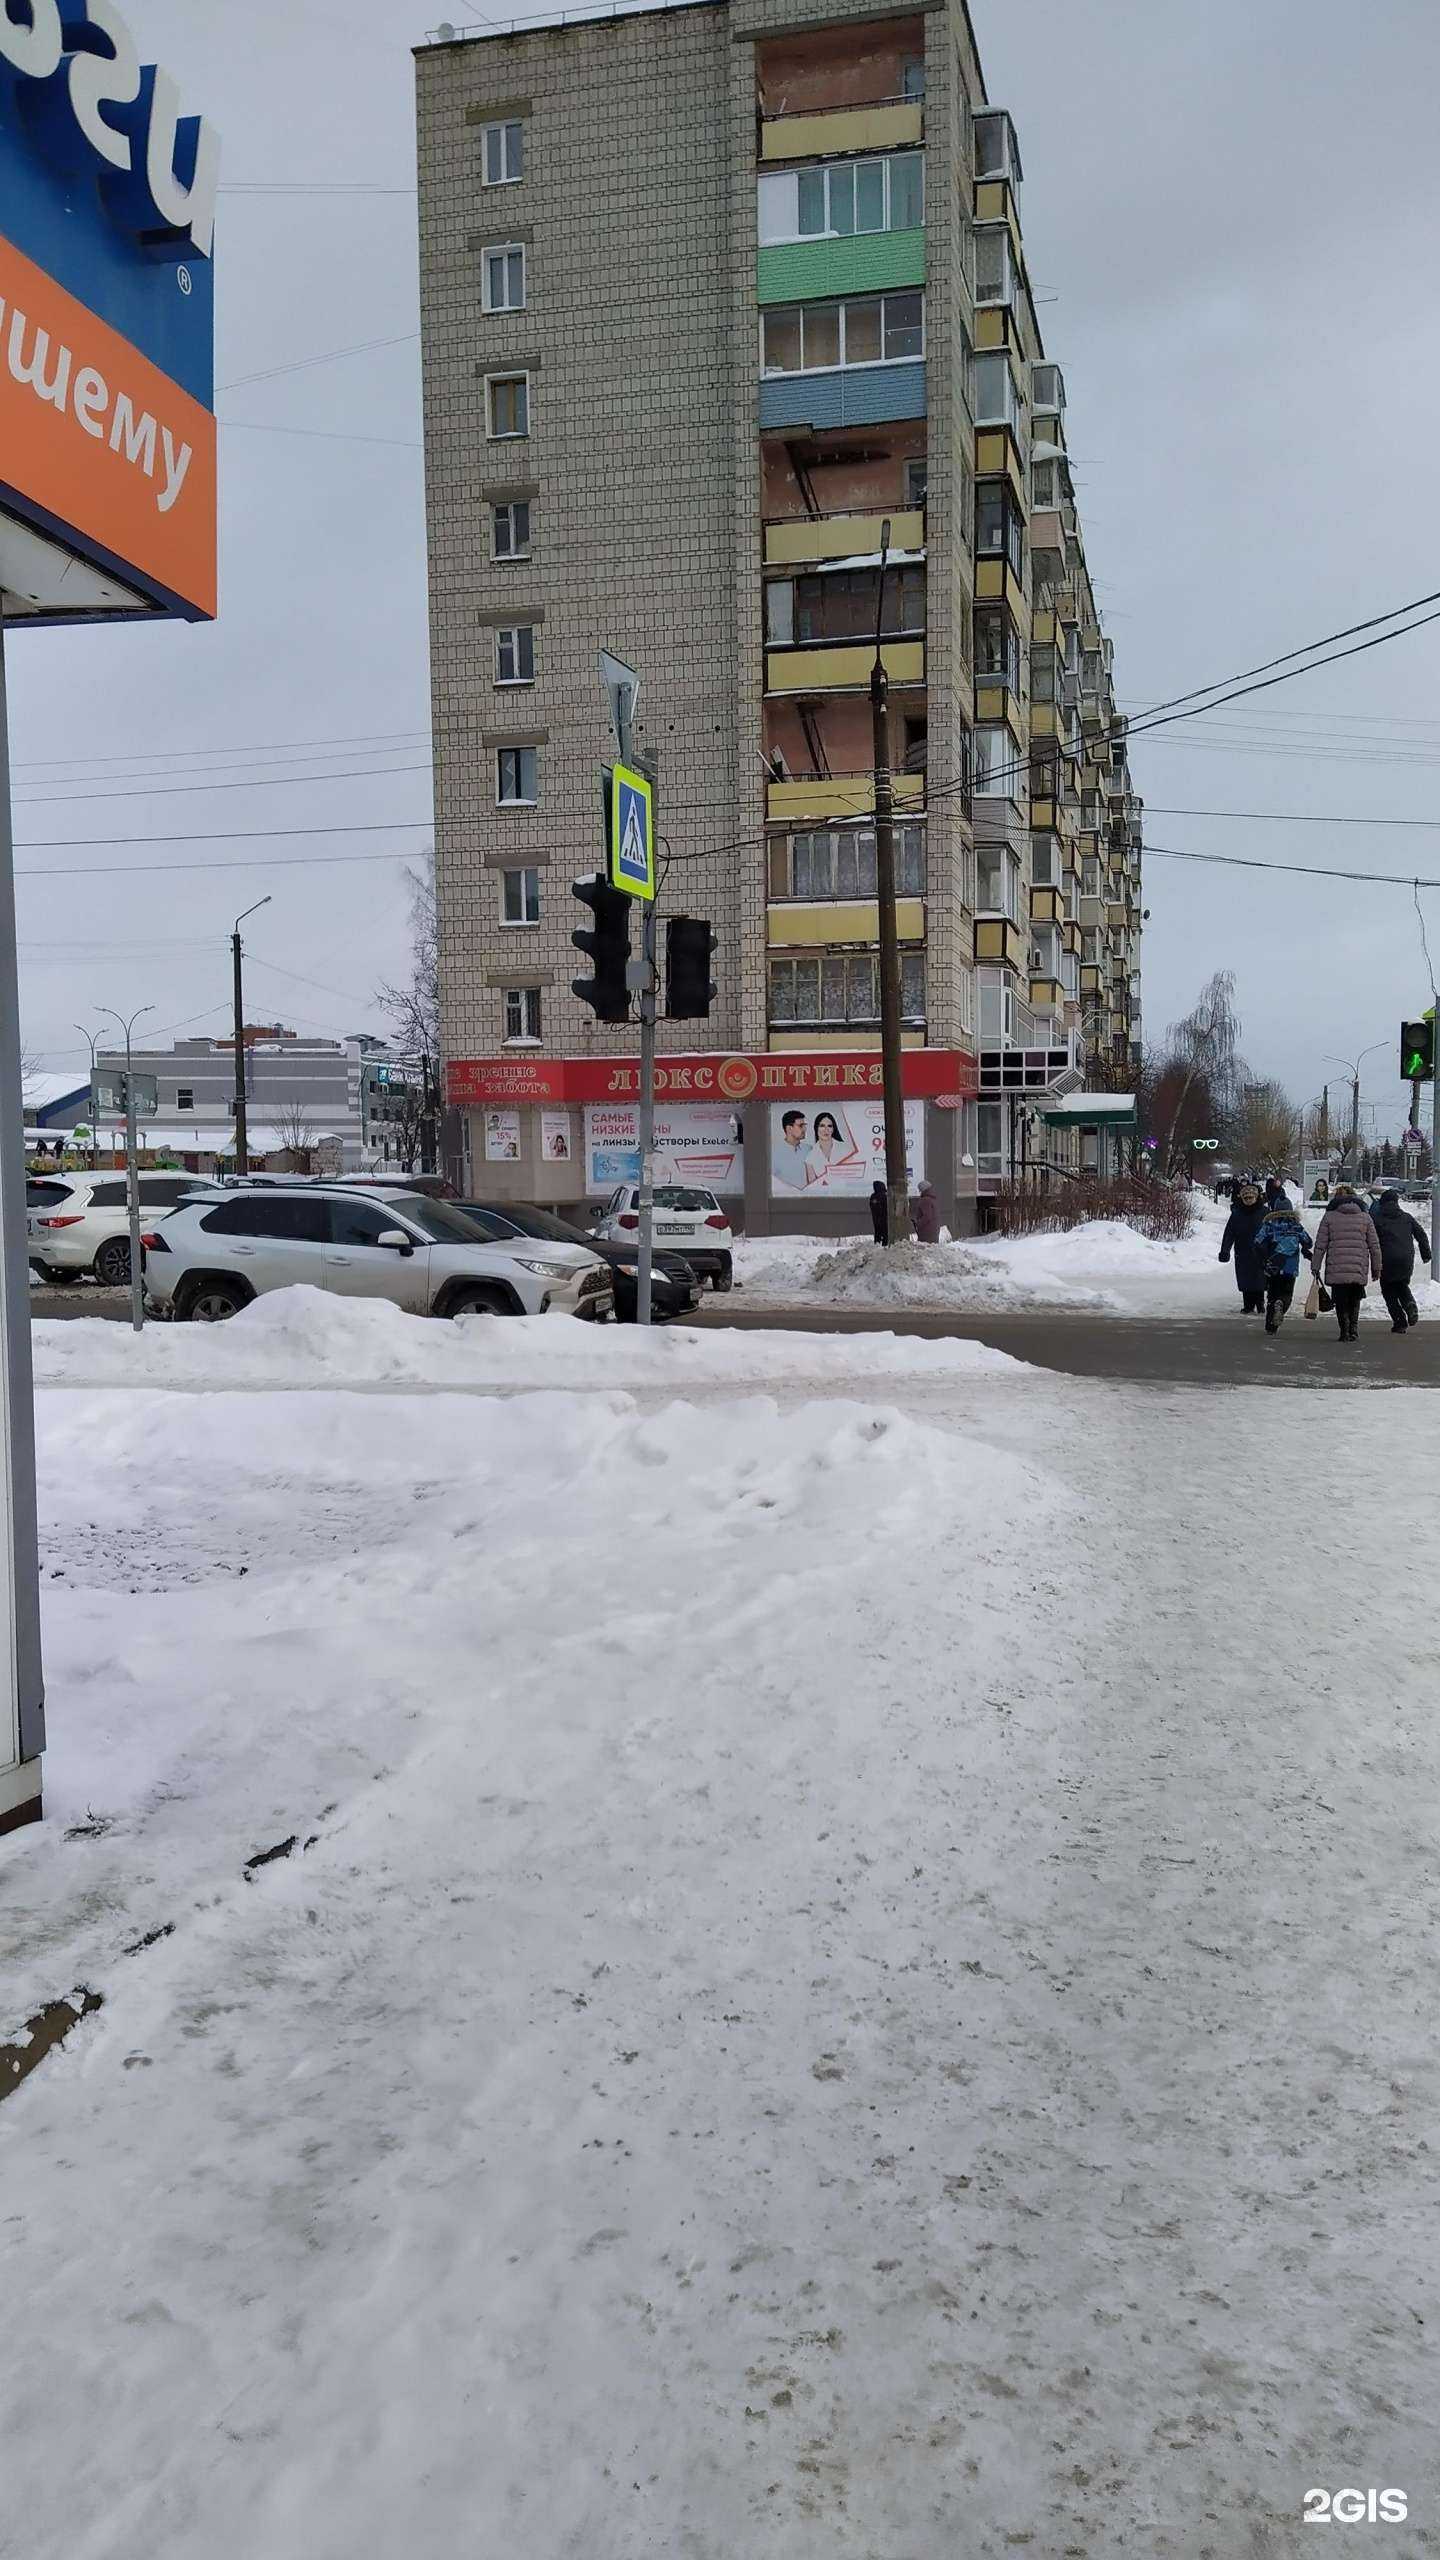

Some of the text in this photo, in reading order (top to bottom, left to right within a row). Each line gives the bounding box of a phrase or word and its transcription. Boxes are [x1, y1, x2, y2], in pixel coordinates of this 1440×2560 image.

[0, 297, 192, 512] шему
[484, 1078, 551, 1094] забота
[591, 1113, 634, 1123] САМЫЕ
[591, 1124, 636, 1134] НИЗКИЕ
[602, 1137, 636, 1146] линзы
